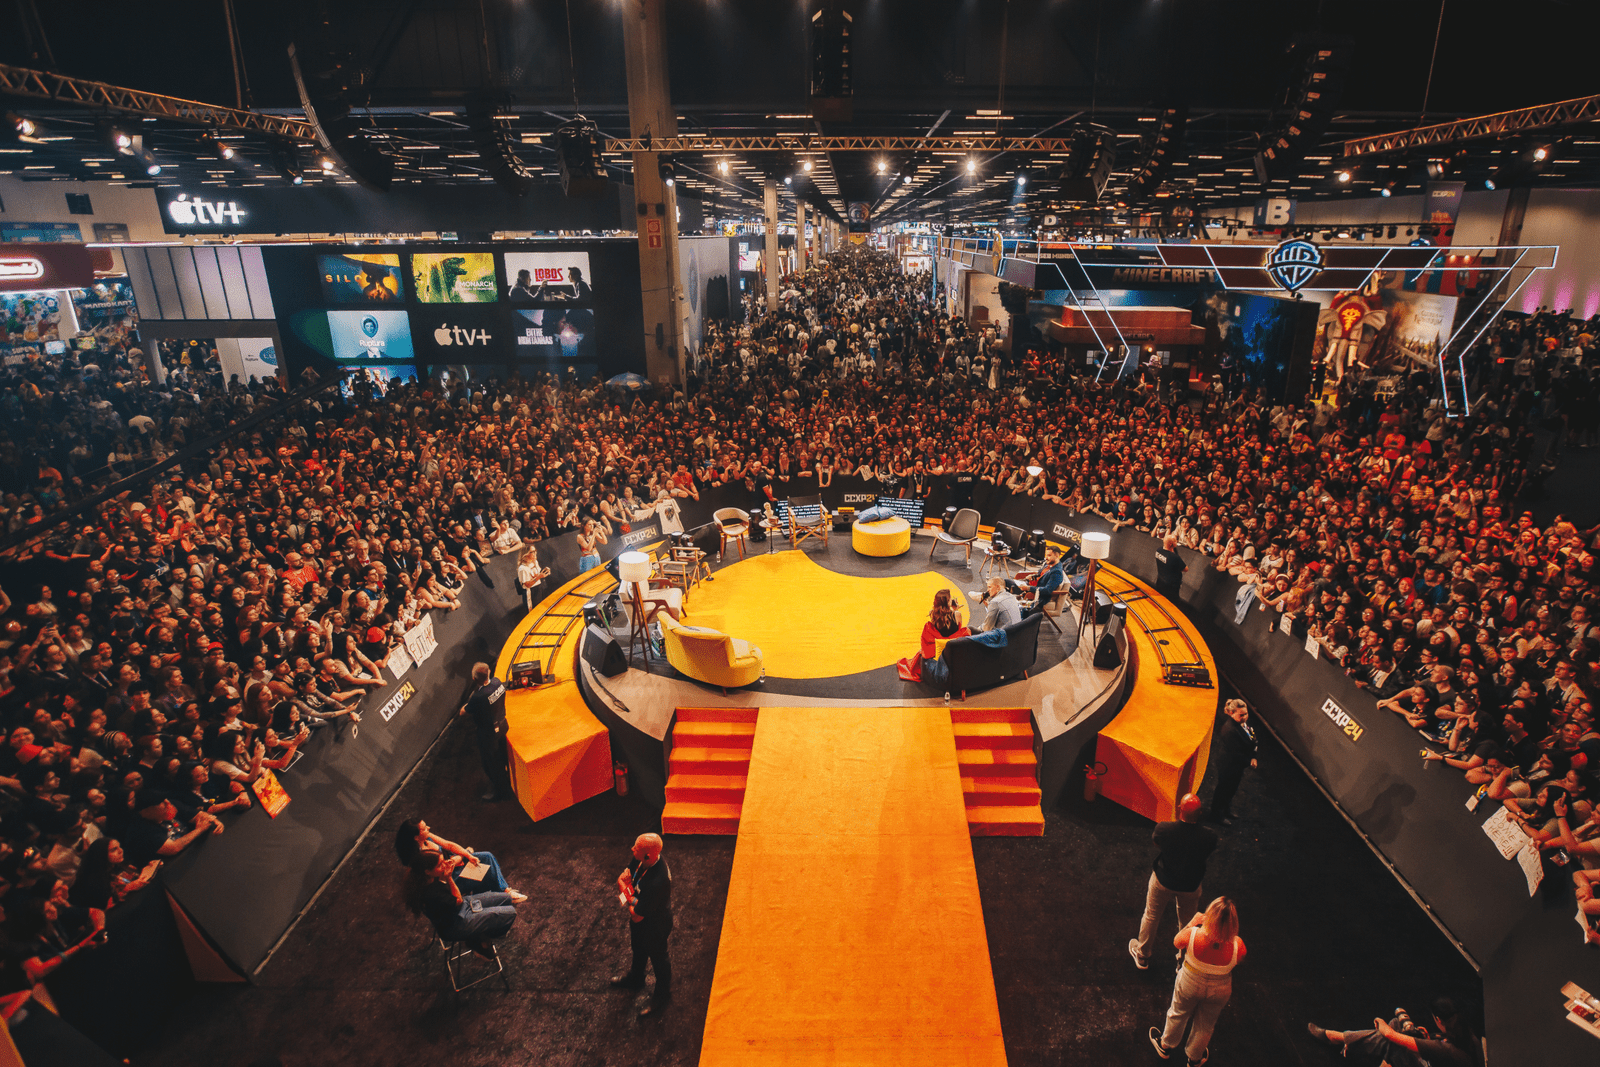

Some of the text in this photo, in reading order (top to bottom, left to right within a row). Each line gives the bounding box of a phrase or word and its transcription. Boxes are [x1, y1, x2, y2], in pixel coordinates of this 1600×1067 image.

[192, 196, 246, 225] tv+
[1266, 199, 1292, 226] B
[458, 280, 494, 288] MONARCH
[535, 267, 564, 282] LOBOS
[1112, 268, 1217, 283] MINECRAFT
[359, 339, 385, 348] Ruptura
[452, 325, 492, 346] tv+
[623, 527, 657, 547] CCXP24
[1052, 524, 1083, 543] CCXP24
[379, 681, 416, 722] CCXP24
[1320, 697, 1364, 742] CCXP24
